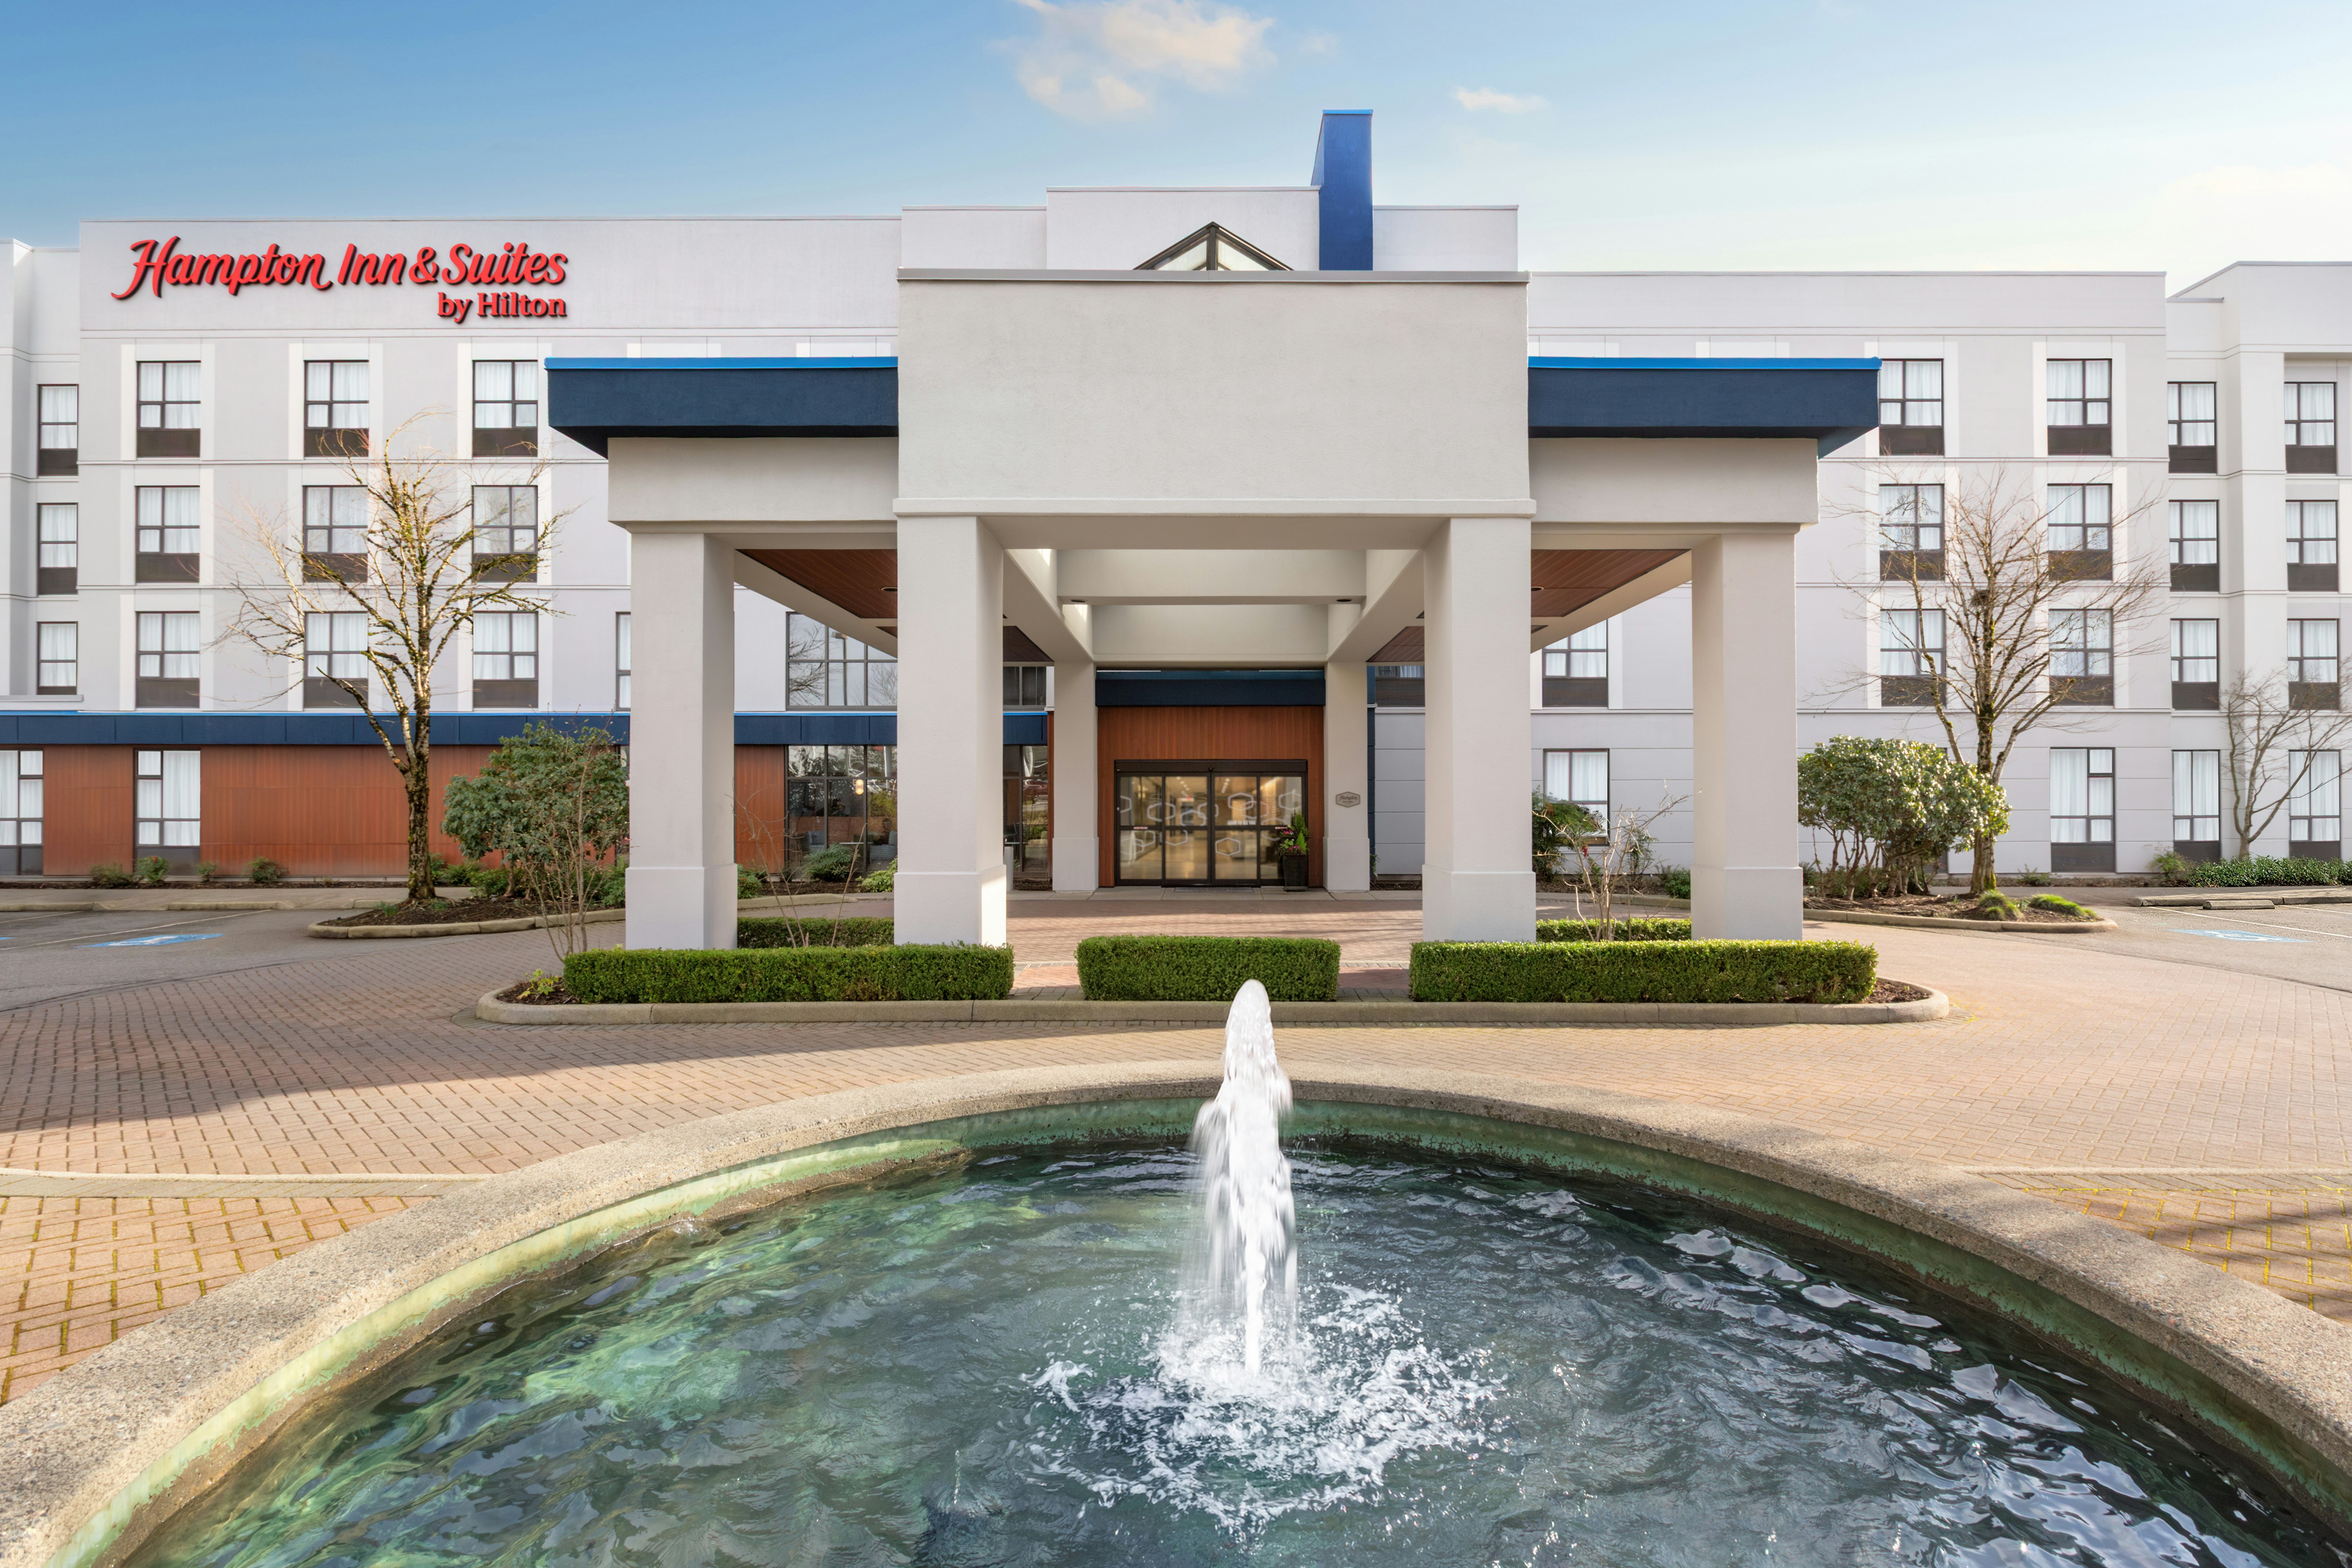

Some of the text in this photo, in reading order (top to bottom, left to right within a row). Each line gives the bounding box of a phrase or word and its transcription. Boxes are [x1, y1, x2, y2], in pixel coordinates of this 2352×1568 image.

[111, 236, 567, 300] Hampton Inn & Suites
[437, 292, 566, 323] by Hilton
